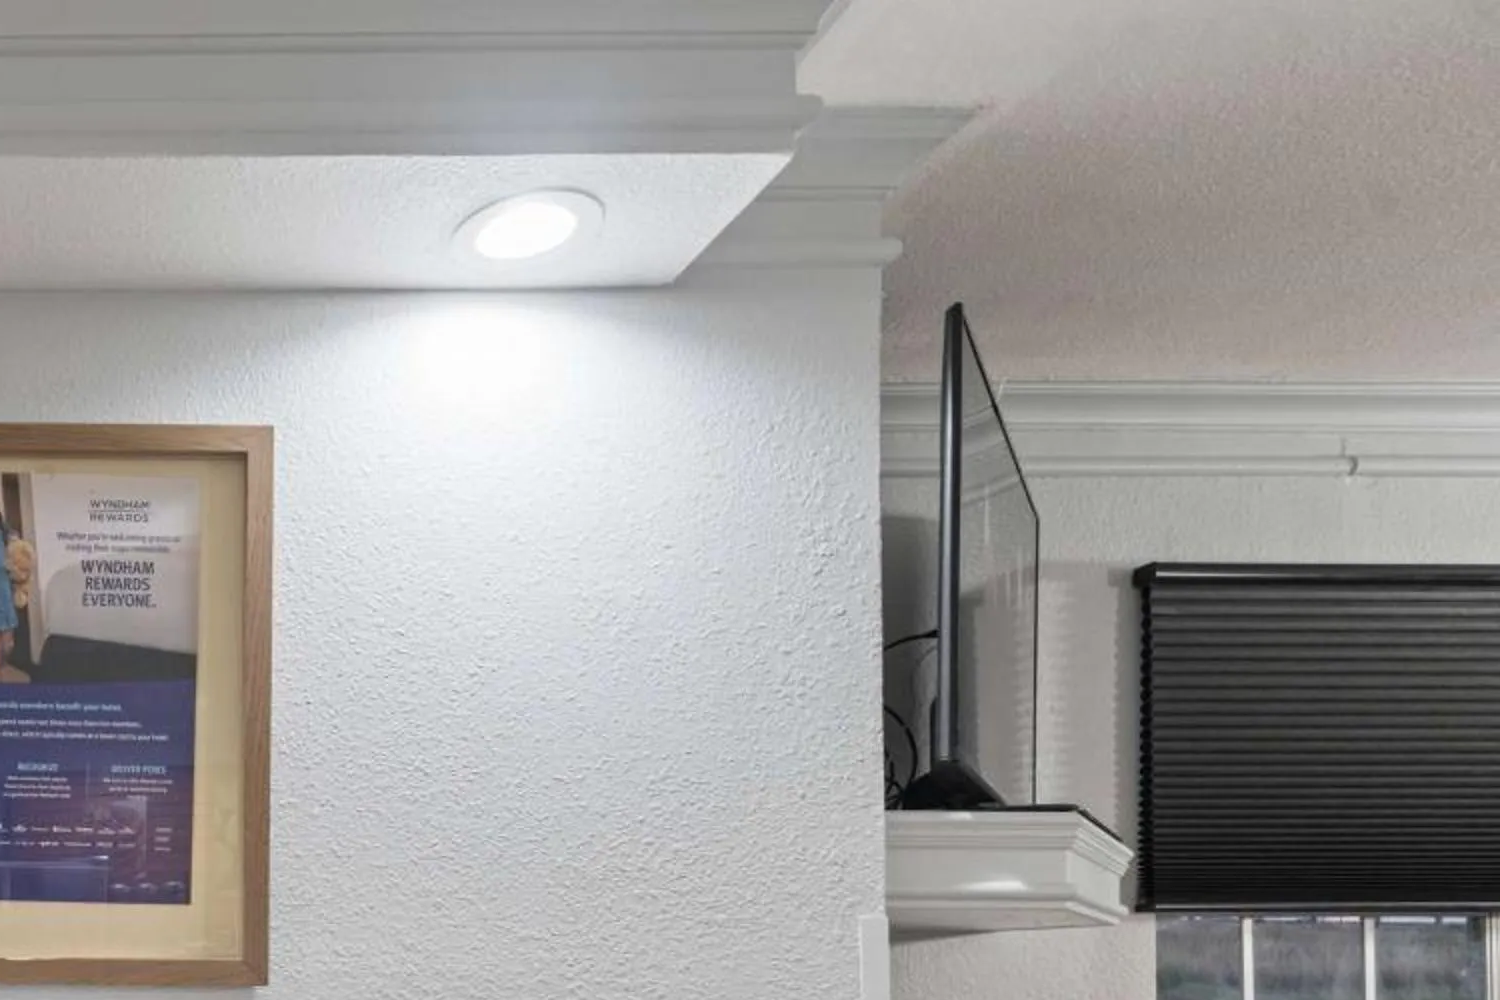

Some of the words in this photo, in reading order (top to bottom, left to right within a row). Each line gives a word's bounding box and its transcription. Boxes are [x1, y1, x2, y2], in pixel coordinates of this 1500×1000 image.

[81, 559, 155, 574] WYNDHAM
[85, 576, 151, 591] REWARDS
[82, 592, 157, 608] EVERYONE.
